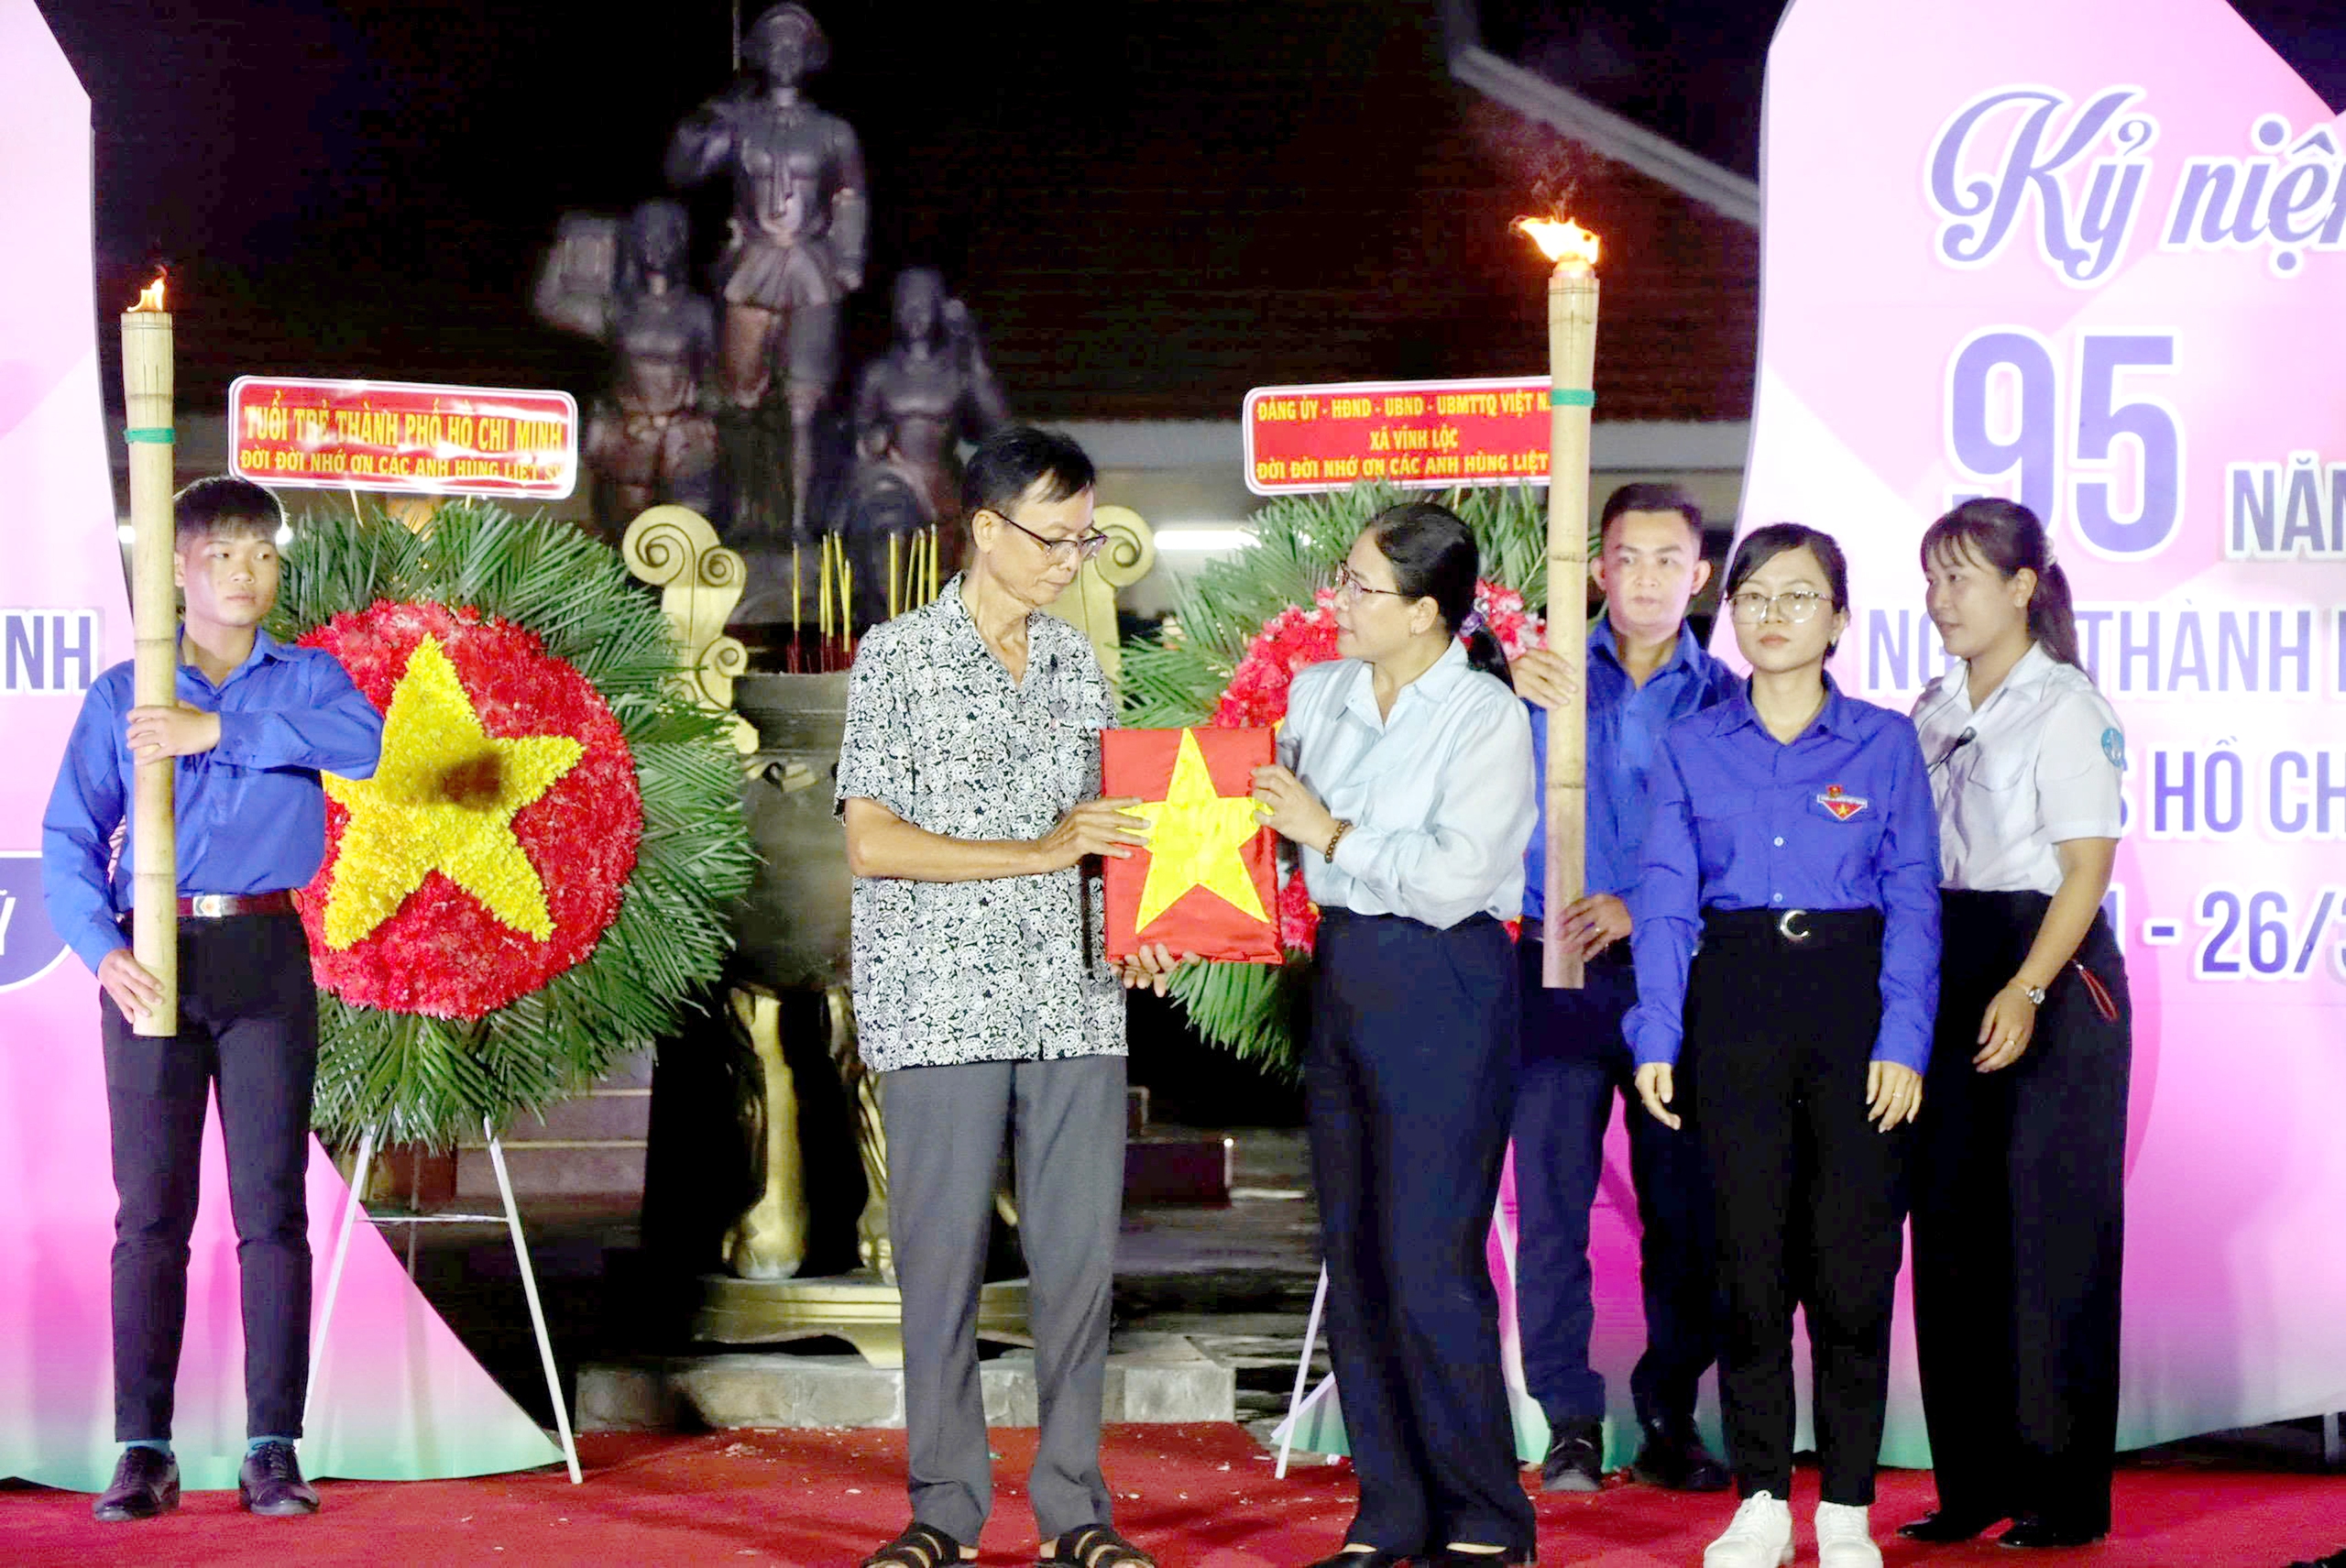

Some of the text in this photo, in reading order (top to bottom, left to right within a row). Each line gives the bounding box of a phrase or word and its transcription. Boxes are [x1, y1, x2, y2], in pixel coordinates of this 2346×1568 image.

[1931, 91, 2153, 281] Kỷ
[245, 389, 289, 440] TUỔI
[335, 401, 399, 446] THÀNH
[405, 398, 442, 448] PHỐ
[515, 420, 562, 452] MINH
[1257, 396, 1297, 421] ĐẢNG
[1332, 399, 1372, 418] HĐND
[1384, 397, 1424, 417] UBND
[1437, 394, 1496, 417] UBMTTQ
[1500, 389, 1533, 418] VIỆT
[1432, 423, 1458, 454] LỘC
[1952, 333, 2178, 553] 95
[240, 444, 270, 469] ĐỜI
[275, 446, 304, 471] ĐỜI
[310, 449, 347, 473] NHỚ
[378, 451, 410, 475] CÁC
[415, 457, 449, 477] ANH
[1256, 456, 1285, 479] ĐỜI
[1290, 456, 1319, 478] ĐỜI
[1323, 455, 1358, 477] NHỚ
[1390, 452, 1420, 476] CÁC
[1424, 455, 1459, 475] ANH
[1464, 450, 1507, 472] HÙNG
[1513, 449, 1549, 475] LIỆT
[2232, 457, 2346, 551] NĂ
[2075, 598, 2311, 692] THÀNH
[2154, 736, 2242, 833] HỒ
[2270, 751, 2346, 833] CH
[2202, 890, 2346, 974] 26/
